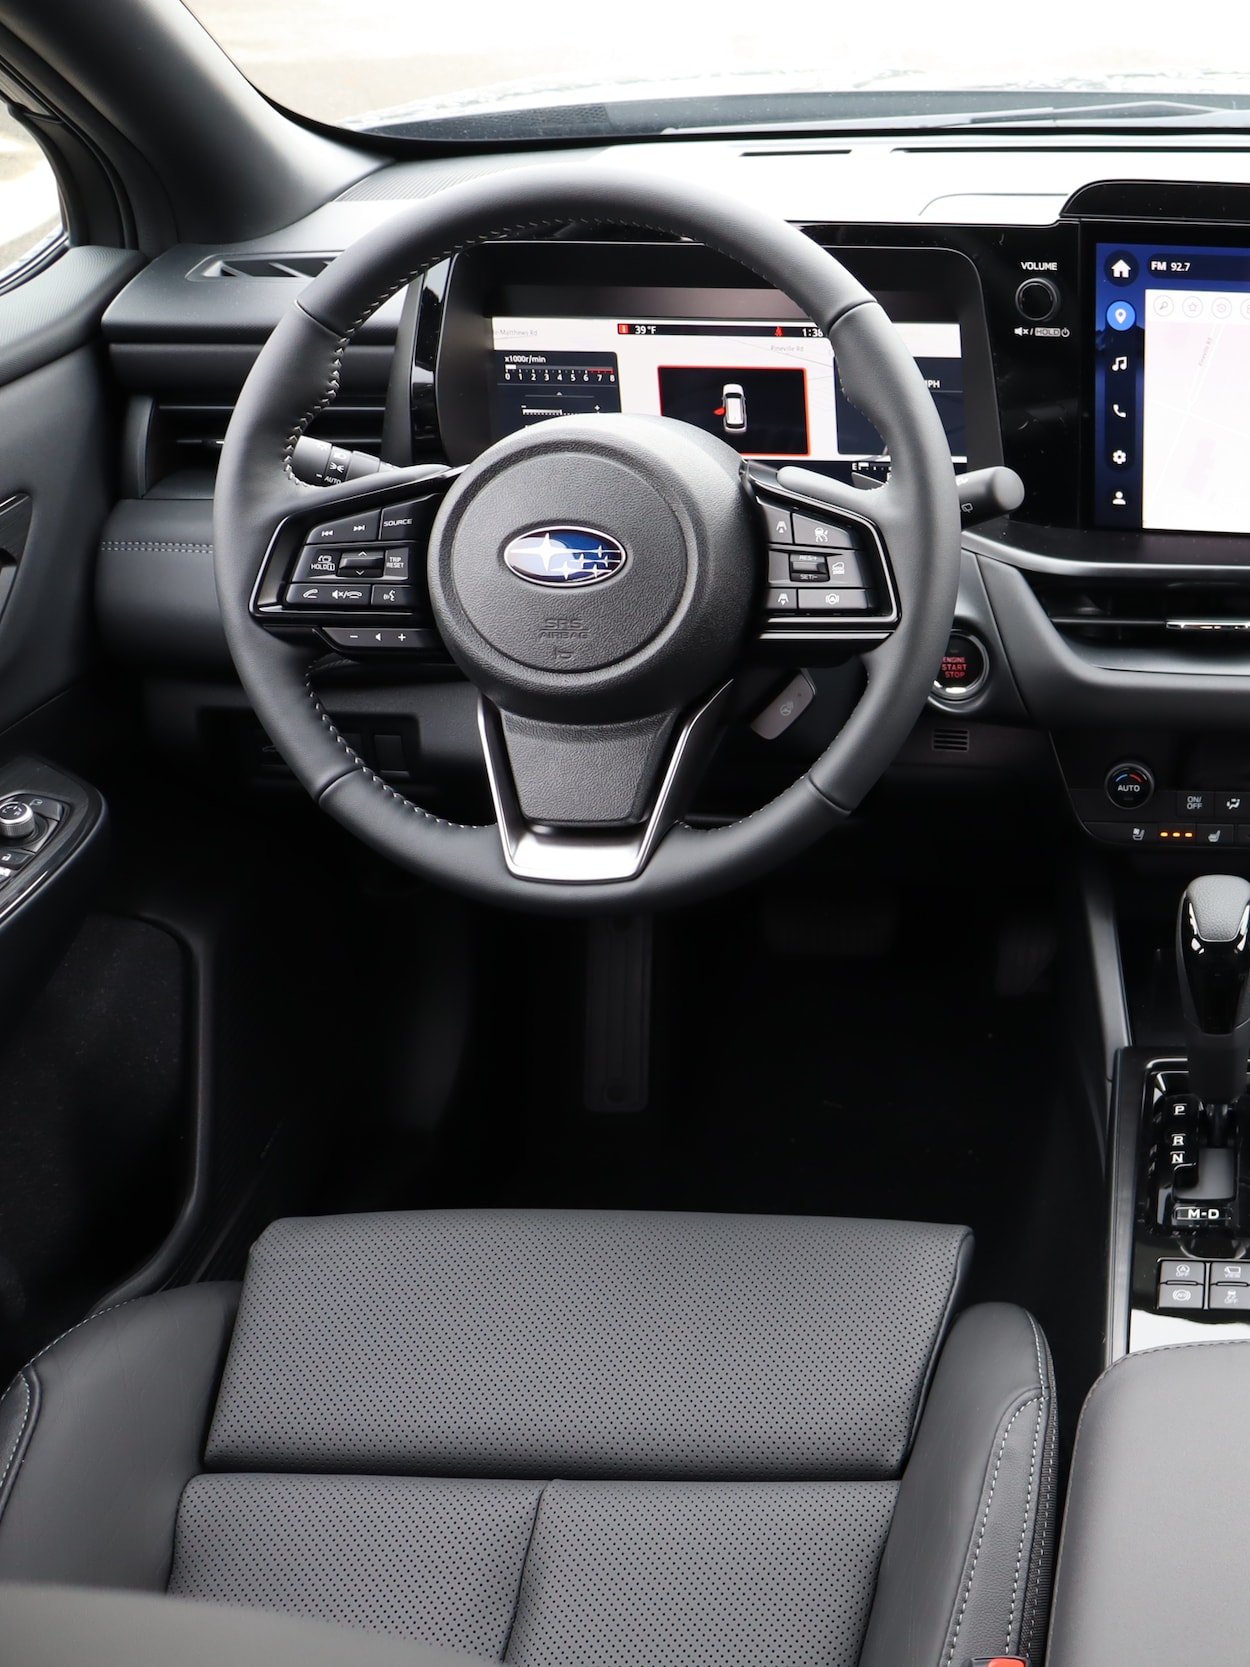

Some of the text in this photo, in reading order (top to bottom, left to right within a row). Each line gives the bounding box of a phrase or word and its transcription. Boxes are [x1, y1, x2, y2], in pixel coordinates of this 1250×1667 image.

[1021, 262, 1057, 270] VOLUME
[1151, 261, 1191, 271] FM 92.7
[1036, 328, 1060, 336] HOLD
[505, 355, 546, 364] x1000r/min
[324, 476, 342, 484] AUTO
[383, 518, 413, 527] SOURCE
[311, 563, 327, 571] HOLD
[544, 619, 583, 630] SRS
[540, 631, 589, 639] AIRBAG
[945, 671, 965, 679] STOP
[1174, 1106, 1185, 1114] P
[1172, 1136, 1184, 1145] R
[1171, 1154, 1184, 1163] N
[1188, 1209, 1219, 1219] M-D
